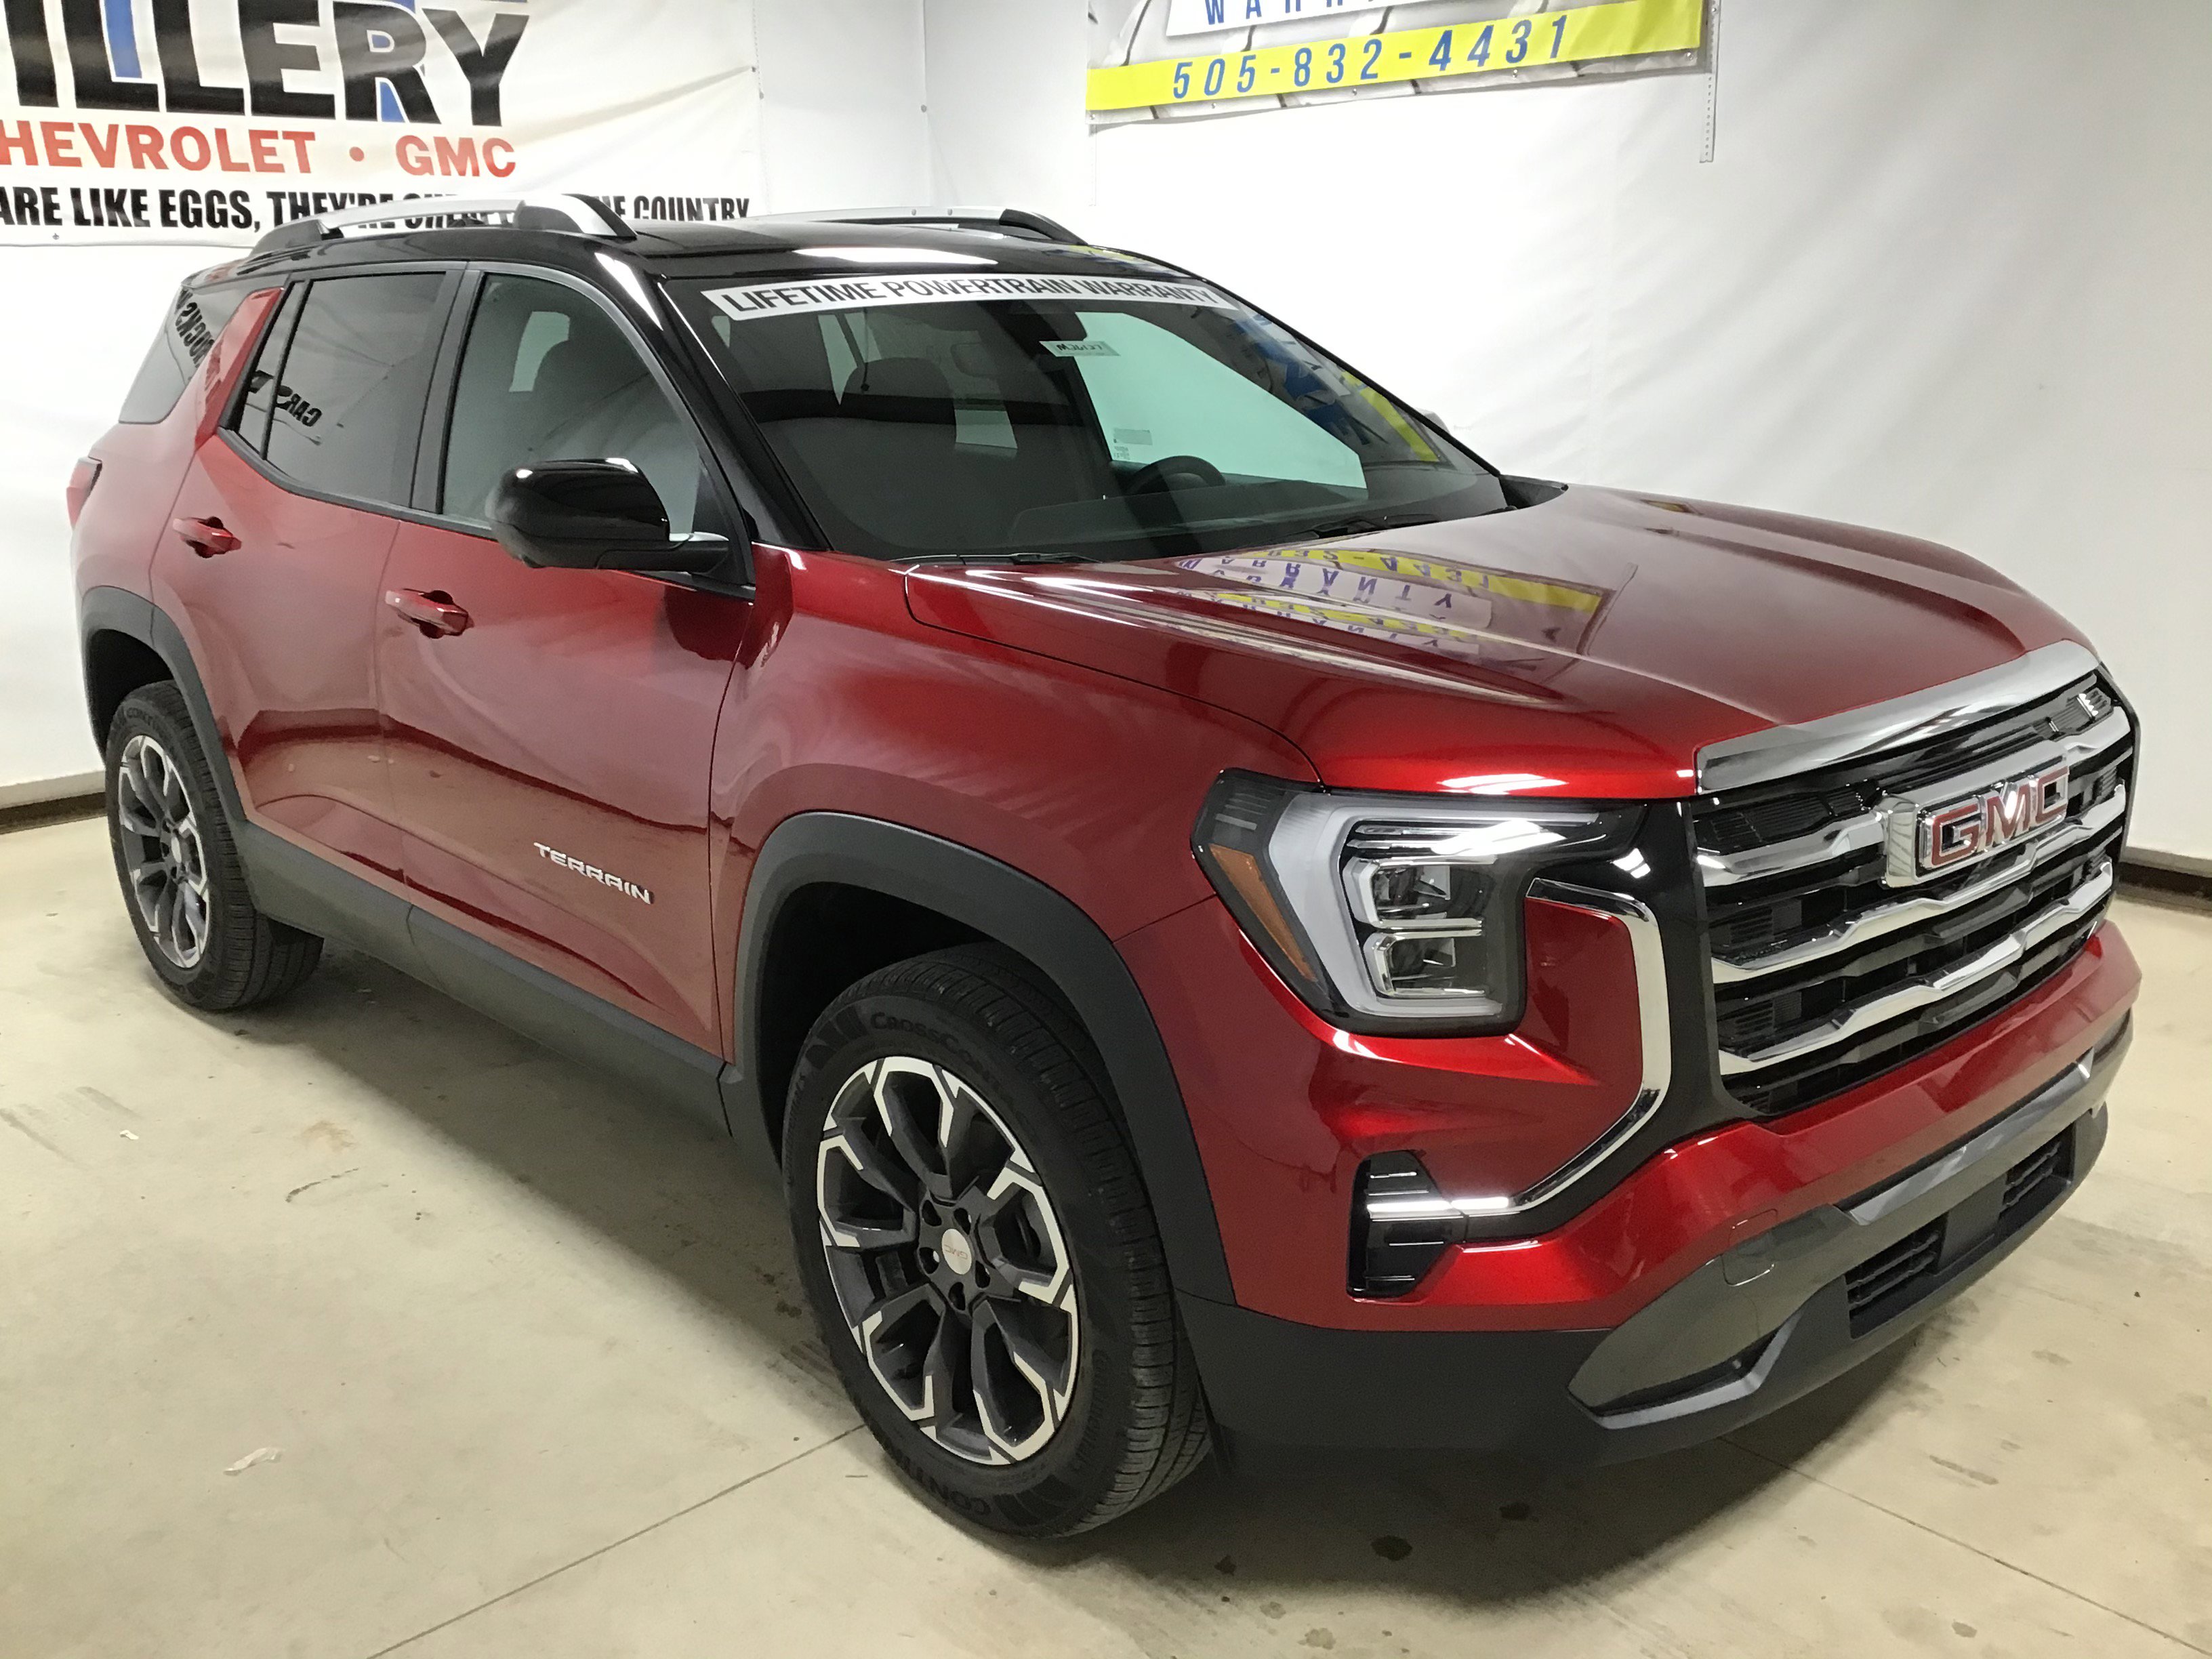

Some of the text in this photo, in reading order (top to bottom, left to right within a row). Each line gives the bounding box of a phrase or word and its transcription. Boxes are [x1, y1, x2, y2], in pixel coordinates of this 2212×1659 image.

[1173, 15, 1567, 98] 505-832-4431
[395, 136, 516, 178] GMC
[70, 187, 150, 228] LIKE
[158, 189, 261, 233] EGGS,
[721, 279, 1218, 312] LIFETIME POWERTRAIN WARRANTY
[1931, 766, 2069, 867] GMC
[533, 842, 651, 905] TERRAIN
